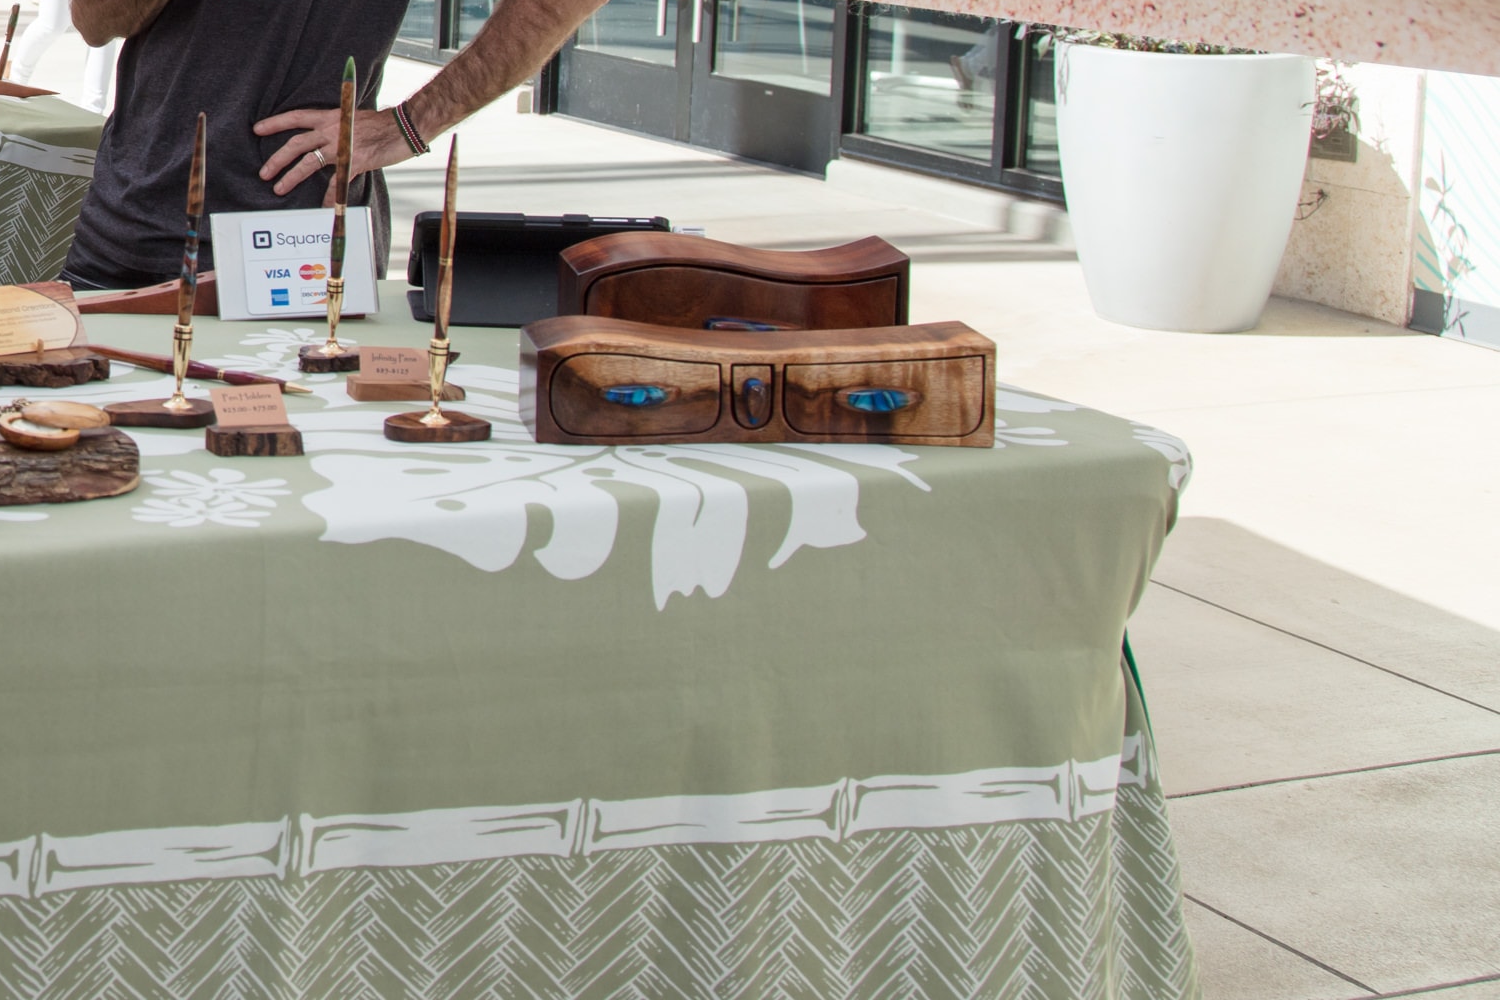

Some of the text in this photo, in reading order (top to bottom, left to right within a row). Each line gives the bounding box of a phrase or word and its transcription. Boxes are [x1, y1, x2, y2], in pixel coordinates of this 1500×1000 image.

[276, 232, 331, 247] Square
[264, 269, 291, 279] VISA
[399, 353, 417, 363] Pens
[222, 391, 272, 402] Pen Holders
